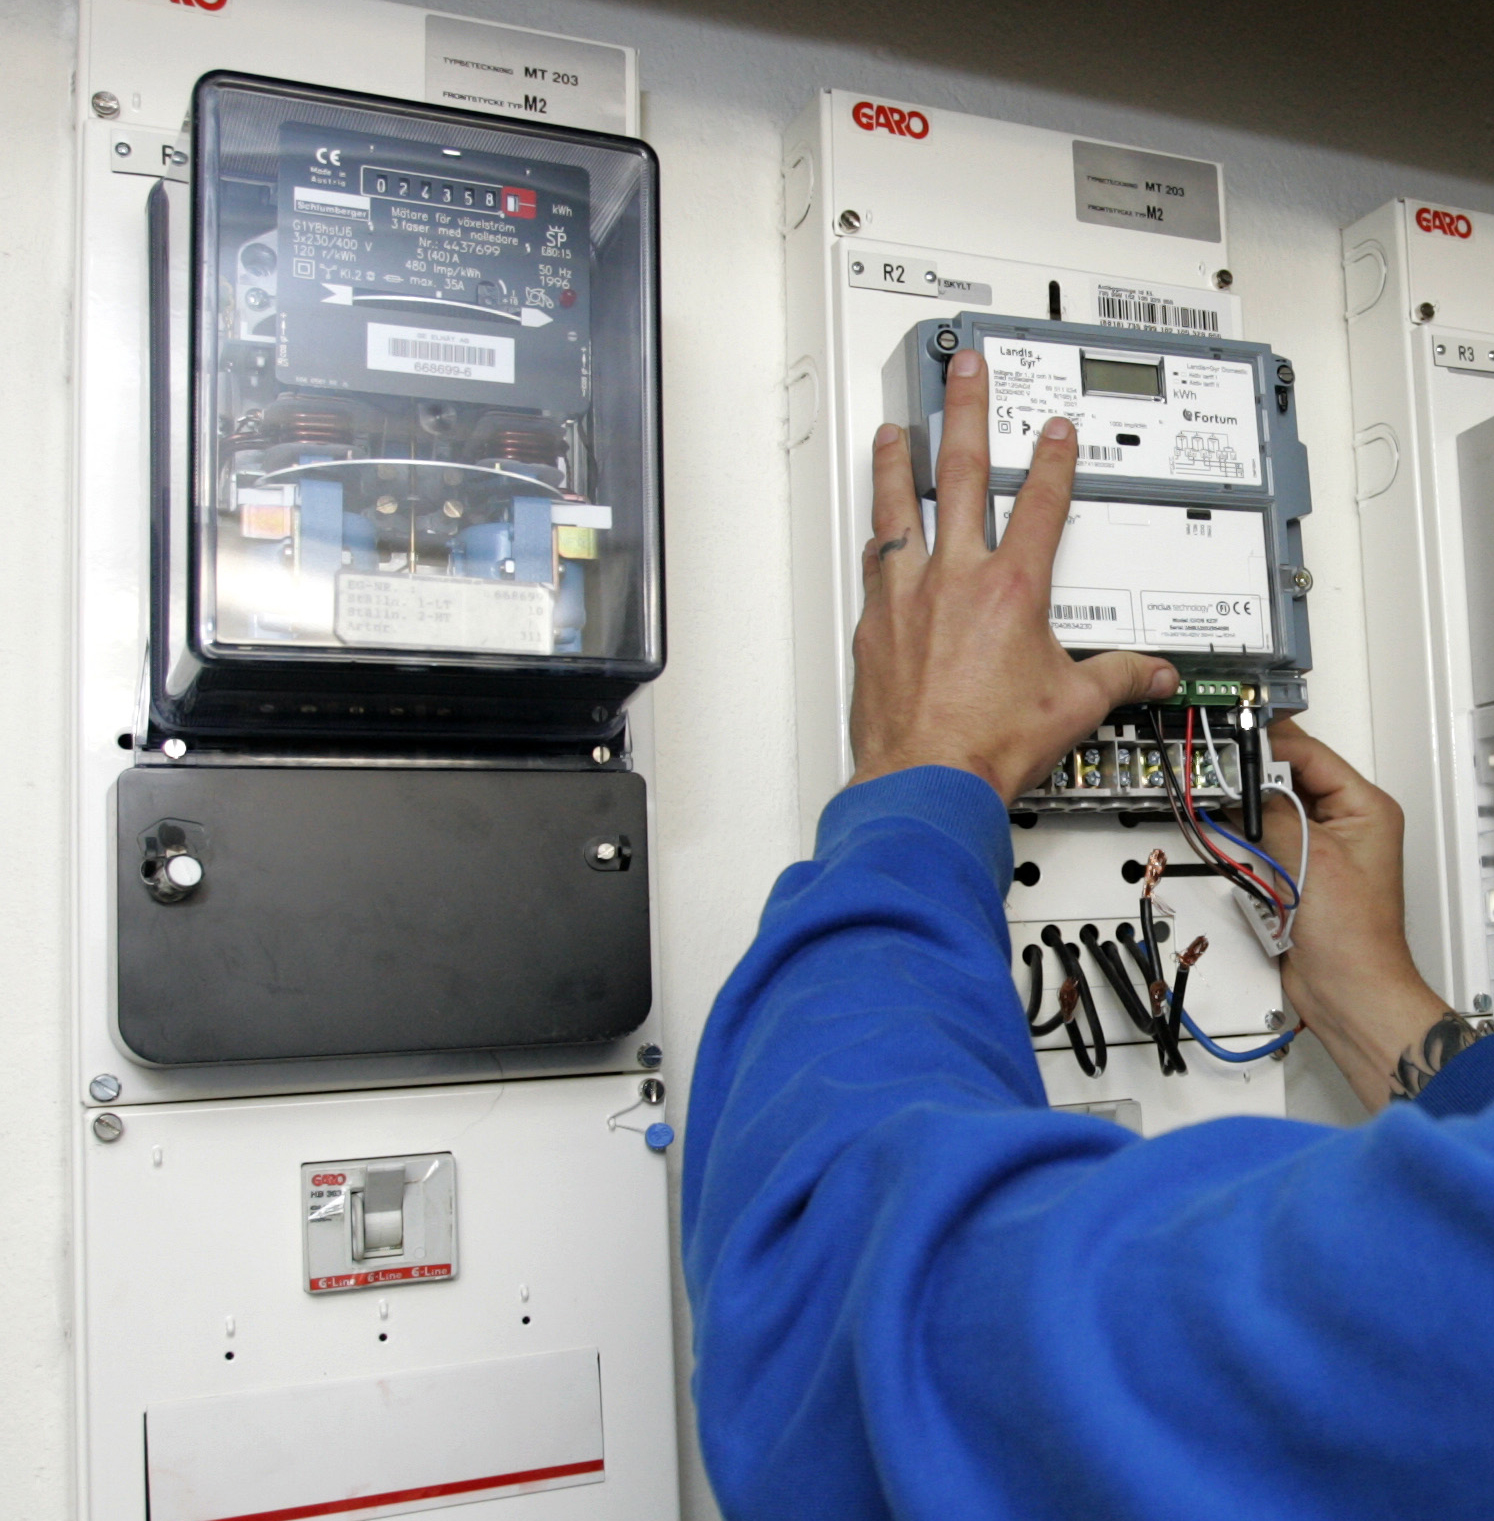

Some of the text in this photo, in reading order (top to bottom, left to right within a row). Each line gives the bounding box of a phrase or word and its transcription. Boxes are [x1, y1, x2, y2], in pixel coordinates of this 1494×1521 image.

[524, 66, 547, 80] MT
[552, 72, 579, 86] 203
[524, 94, 547, 114] M2
[852, 101, 929, 139] GARO
[310, 166, 346, 177] Made in
[311, 176, 346, 187] Austria
[1145, 181, 1161, 192] MT
[1165, 185, 1184, 197] 203
[297, 201, 367, 218] Schlumberger
[552, 205, 572, 217] kWh
[1146, 205, 1163, 221] M2
[391, 206, 516, 233] Mätare för växelström
[1416, 207, 1472, 239] GARO
[391, 218, 519, 246] 3 faser med nolledare
[293, 231, 373, 251] 3x230/400 V
[443, 240, 501, 256] 4437699
[293, 245, 357, 262] 120 r/kWh
[405, 259, 427, 272] 480
[538, 264, 572, 279] 50 Hz
[883, 263, 905, 283] R2
[410, 277, 465, 292] max. 35A
[540, 276, 570, 290] 1996
[944, 281, 971, 290] SKYLT
[1000, 346, 1033, 357] Landis
[1458, 345, 1475, 362] R3
[1020, 359, 1036, 369] Gyr
[1173, 389, 1196, 401] kWh
[1194, 411, 1238, 426] Fortum
[318, 1266, 448, 1288] G-Line G-Line G-Line
